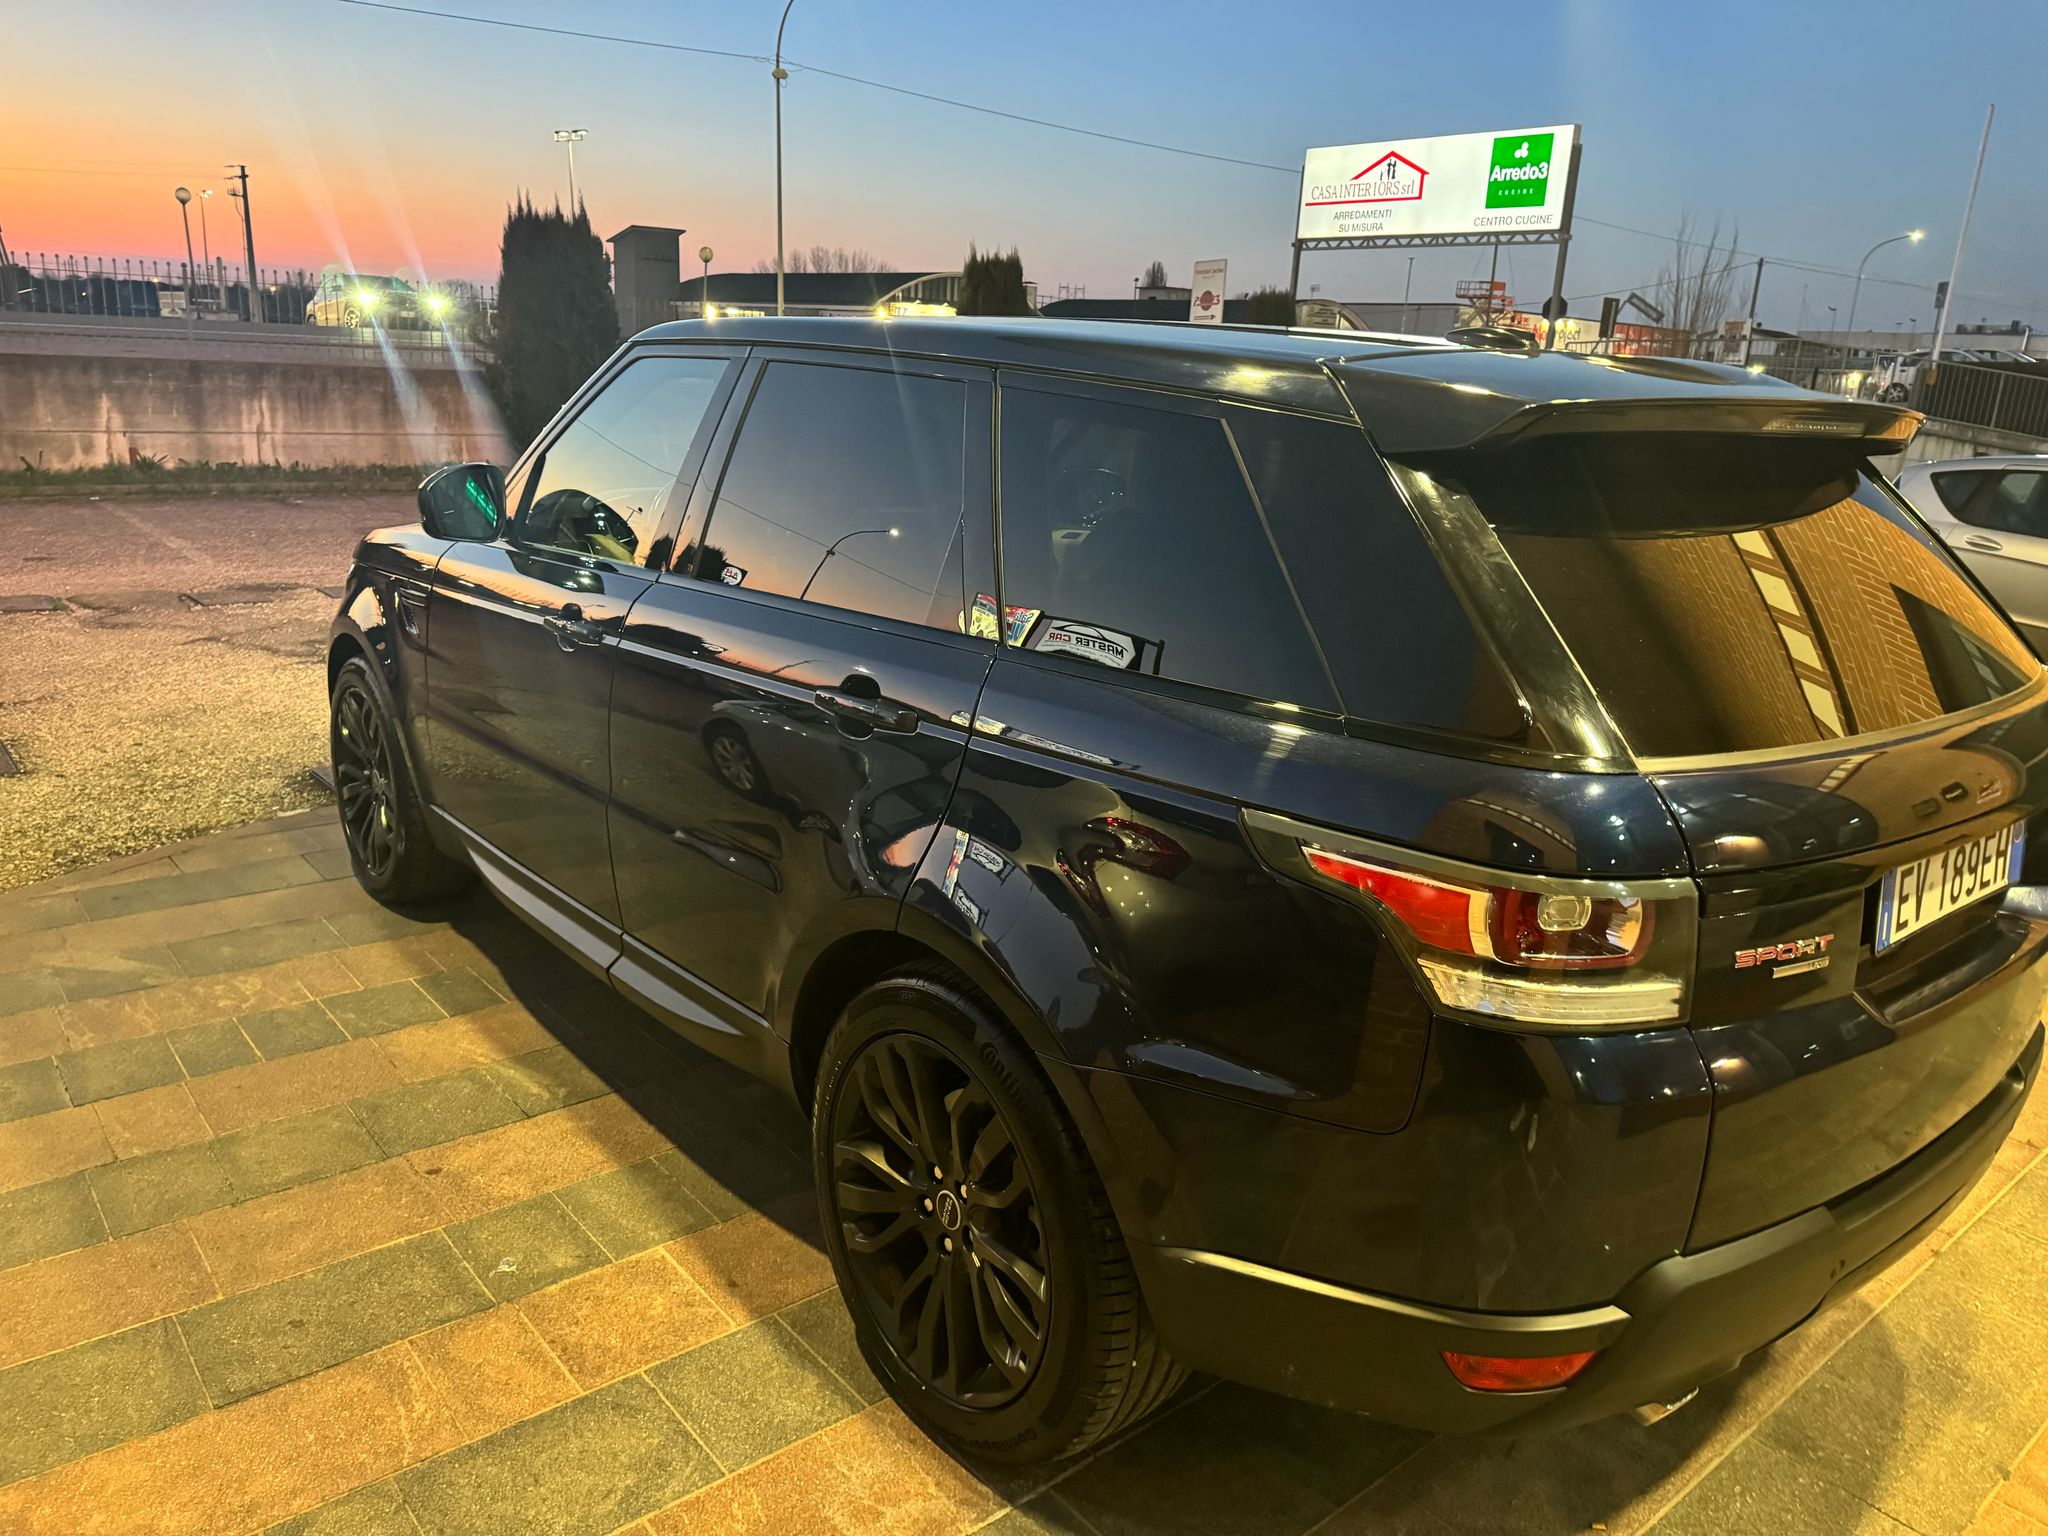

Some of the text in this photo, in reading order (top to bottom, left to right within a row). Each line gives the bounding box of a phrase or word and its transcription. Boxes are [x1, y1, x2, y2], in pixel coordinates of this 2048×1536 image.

[1490, 162, 1548, 182] Arredo3
[1333, 209, 1392, 220] ARREDAMENTI
[1473, 214, 1553, 227] CENTRO CUCINE
[1338, 222, 1383, 233] SU MISURA
[1895, 827, 2010, 934] EV 189EH
[1734, 933, 1835, 969] SPORT
